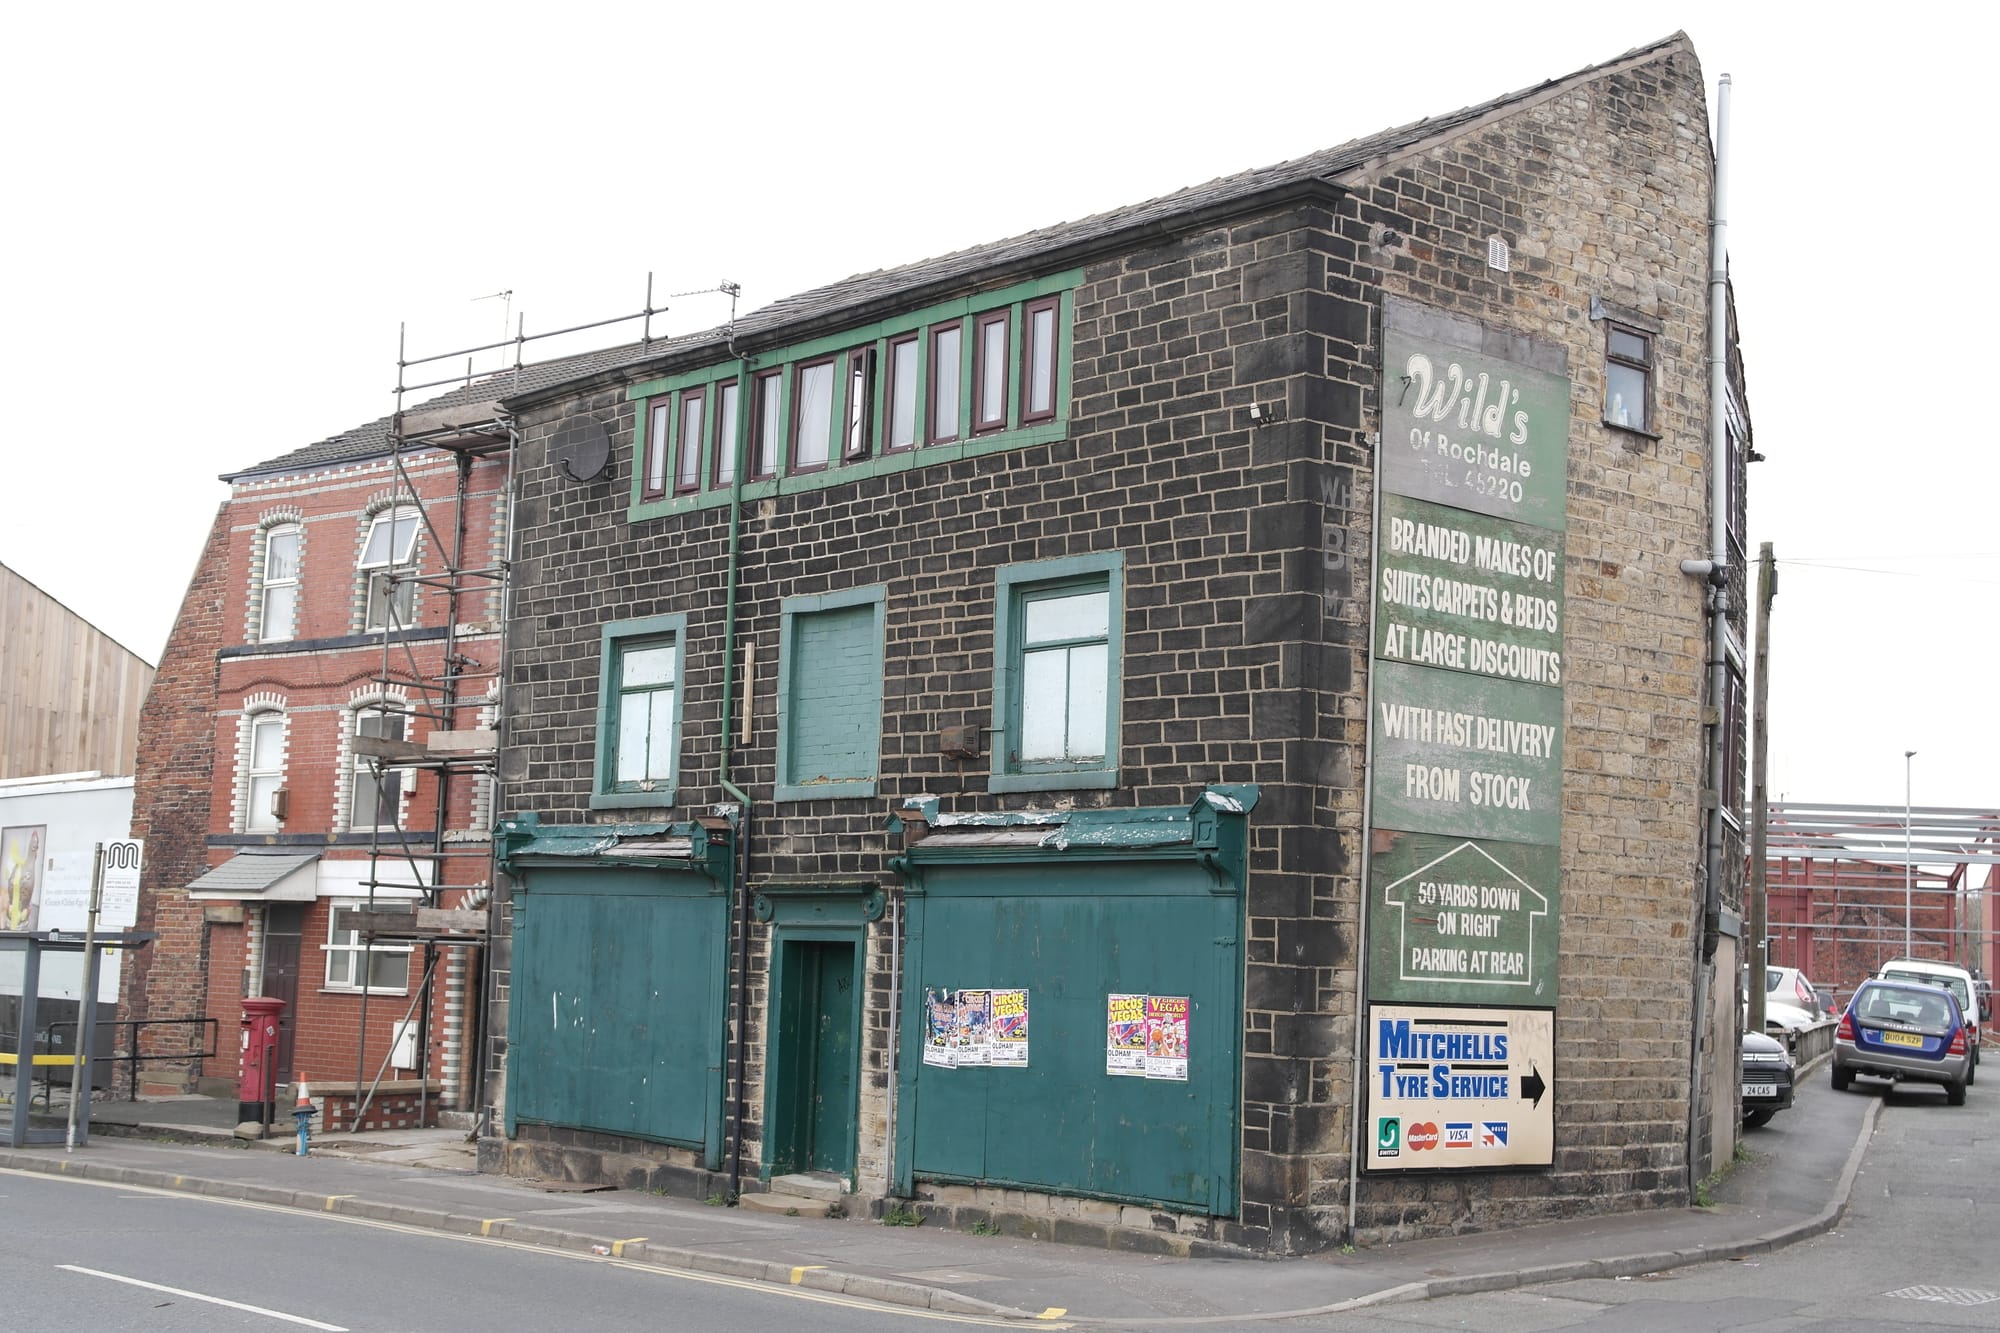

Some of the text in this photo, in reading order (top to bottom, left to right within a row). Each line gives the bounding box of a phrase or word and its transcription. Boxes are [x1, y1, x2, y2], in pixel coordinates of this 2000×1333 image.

[1406, 353, 1529, 445] Wild's
[1437, 435, 1532, 478] Rochdale
[1391, 516, 1556, 583] BRANDED MAKES OF
[1382, 568, 1558, 633] SUITES CARPETS & BEDS
[1383, 623, 1561, 685] AT LARGE DISCOUNTS
[1381, 702, 1556, 759] WITH FAST DELIVERY
[1406, 763, 1531, 811] FROM STOCK
[1418, 881, 1520, 912] 50 YARDS DOWN
[1436, 911, 1501, 938] ON RIGHT
[1411, 947, 1524, 976] PARKING AT REAR
[993, 992, 1024, 1006] CIRCUS
[994, 1003, 1025, 1017] VEGAS
[1109, 998, 1143, 1011] CIRCUS
[1150, 997, 1186, 1013] VEGAS
[1110, 1008, 1144, 1022] VEGAS
[1108, 1049, 1131, 1057] OLDHAM
[1378, 1018, 1509, 1061] MITCHELLS
[1378, 1063, 1509, 1099] TYRE SERVICE
[1408, 1133, 1438, 1143] MasterCard
[1449, 1129, 1468, 1141] VISA
